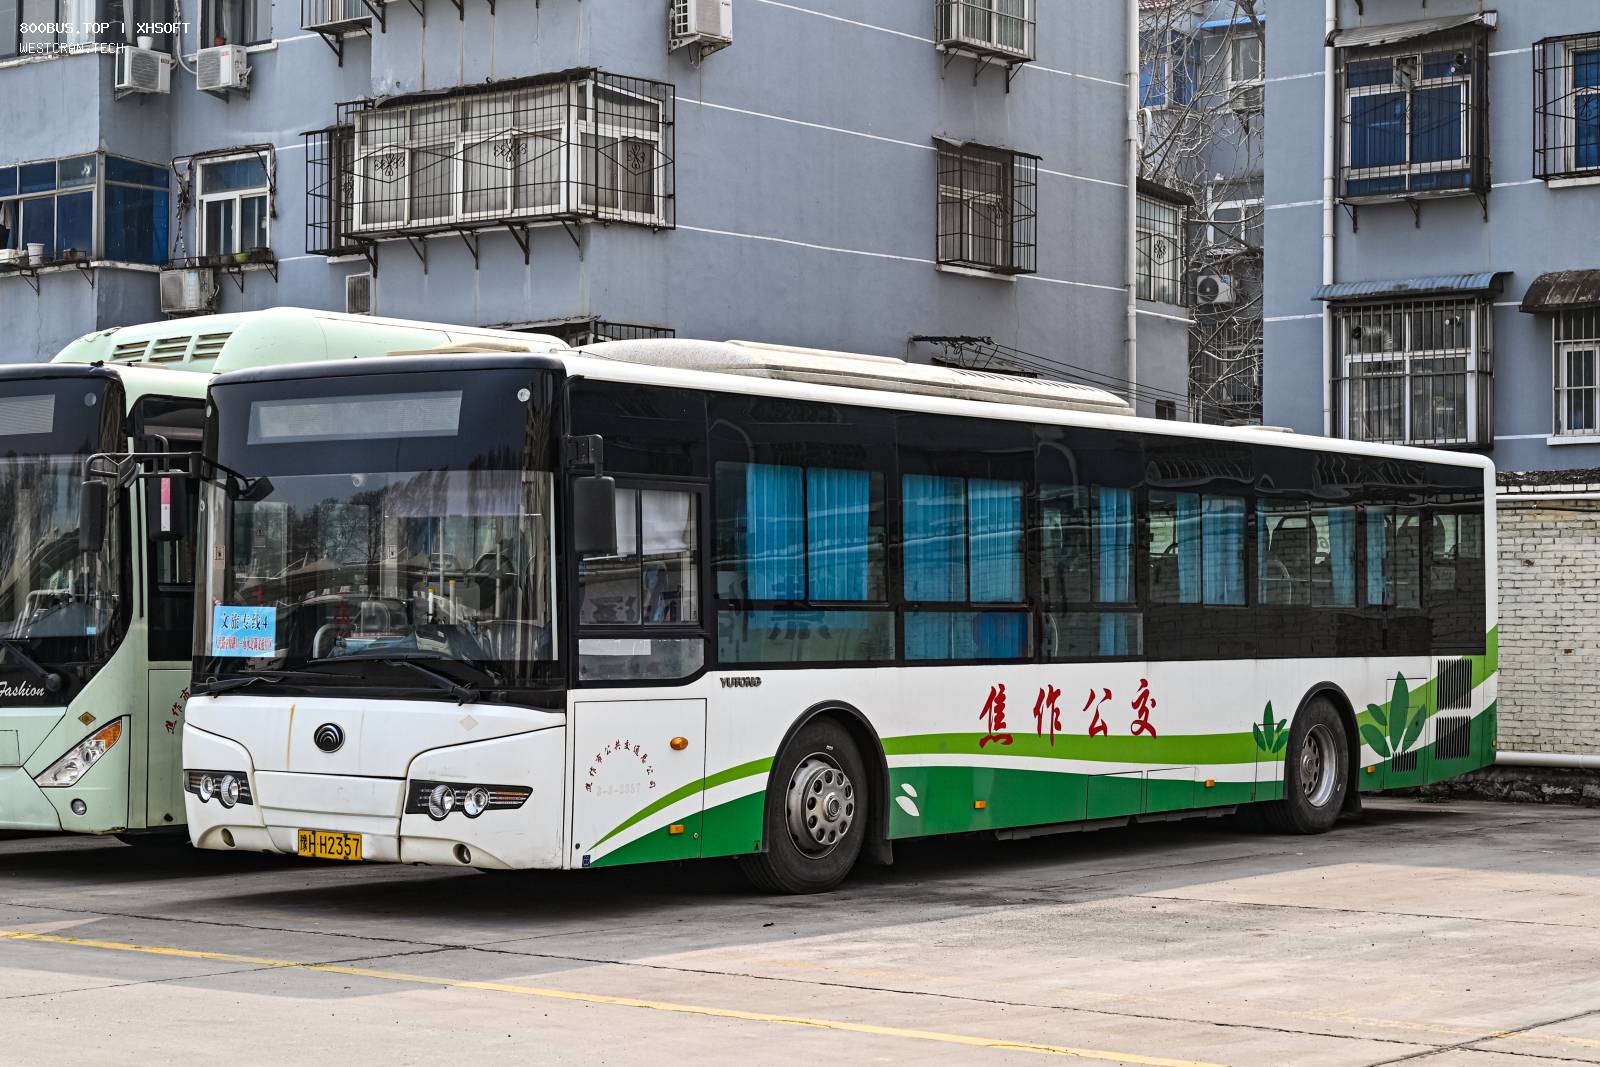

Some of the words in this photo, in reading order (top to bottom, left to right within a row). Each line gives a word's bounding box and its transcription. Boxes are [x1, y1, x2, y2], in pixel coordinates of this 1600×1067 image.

[719, 676, 762, 689] YUTONG
[979, 678, 1157, 749] 焦作公交
